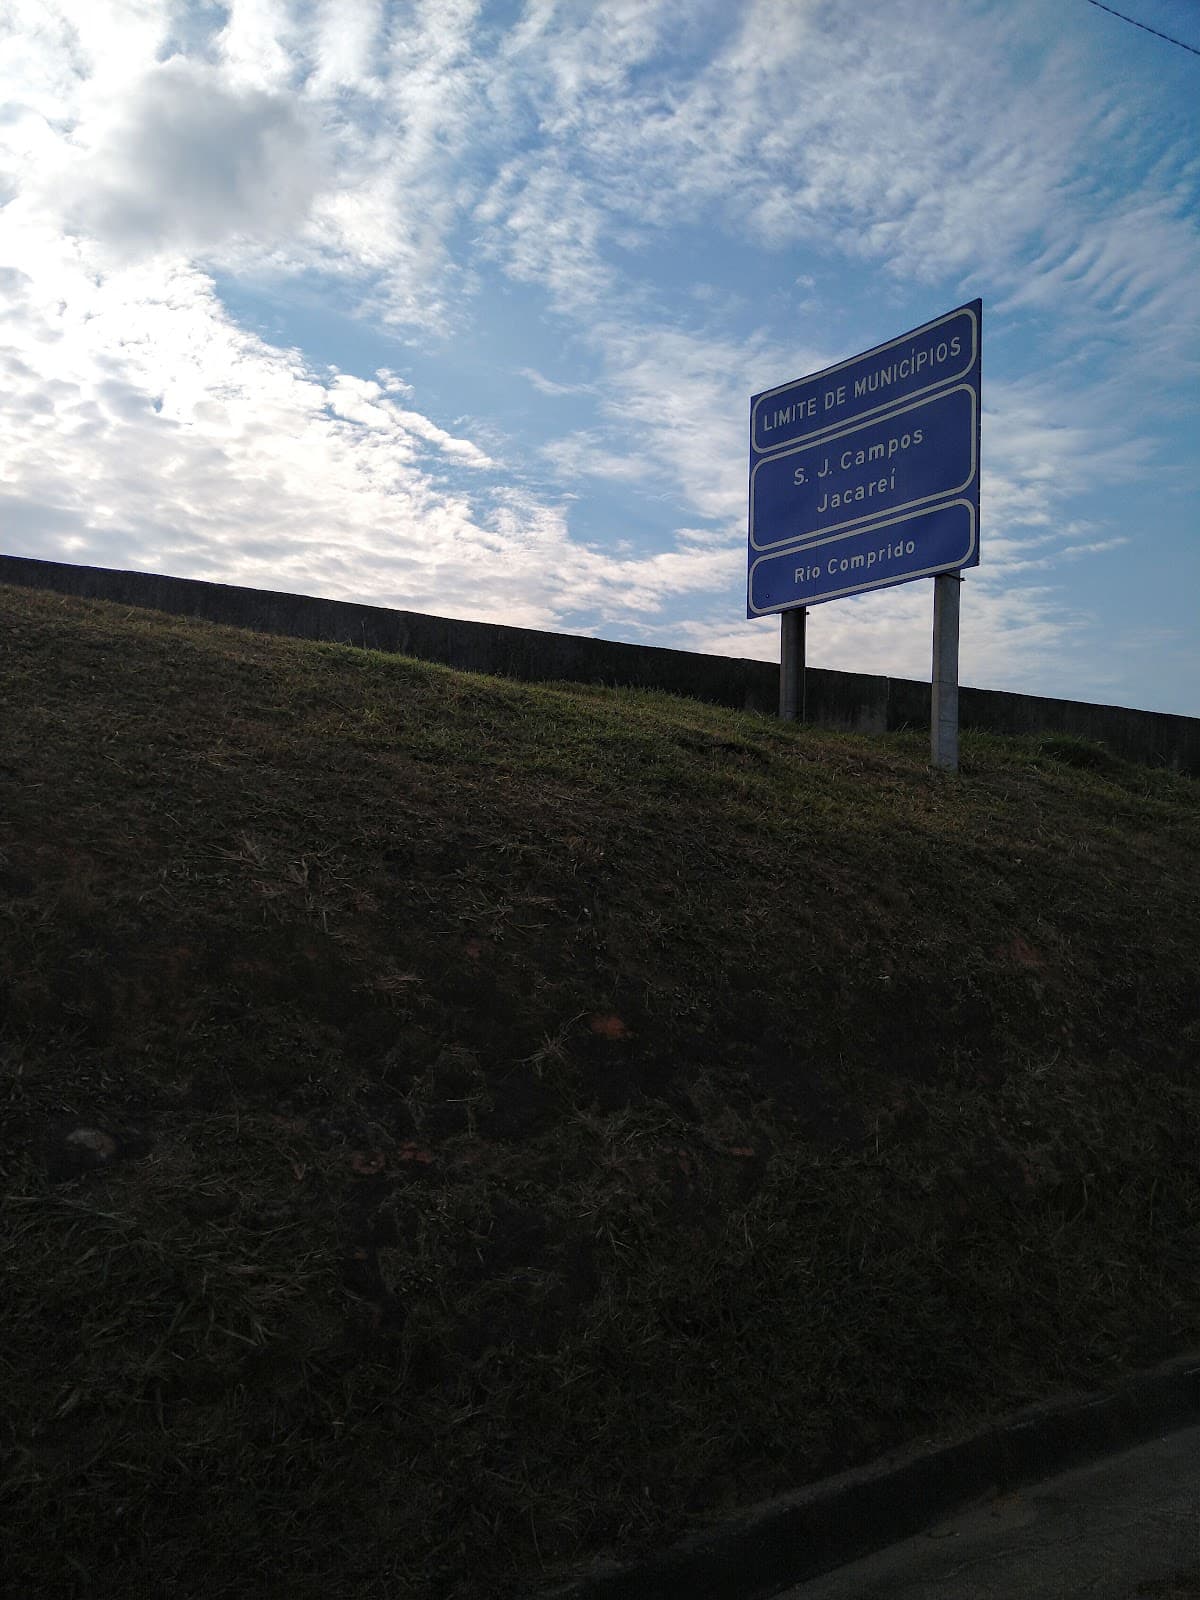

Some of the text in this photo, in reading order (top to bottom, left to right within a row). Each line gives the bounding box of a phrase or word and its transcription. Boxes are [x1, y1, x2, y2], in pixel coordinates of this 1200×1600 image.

[763, 336, 961, 431] LIMITE DE MUNICÍPIOS
[793, 428, 924, 486] S. J. Campos
[816, 467, 896, 513] Jacareí
[794, 538, 916, 584] Rio Comprido
